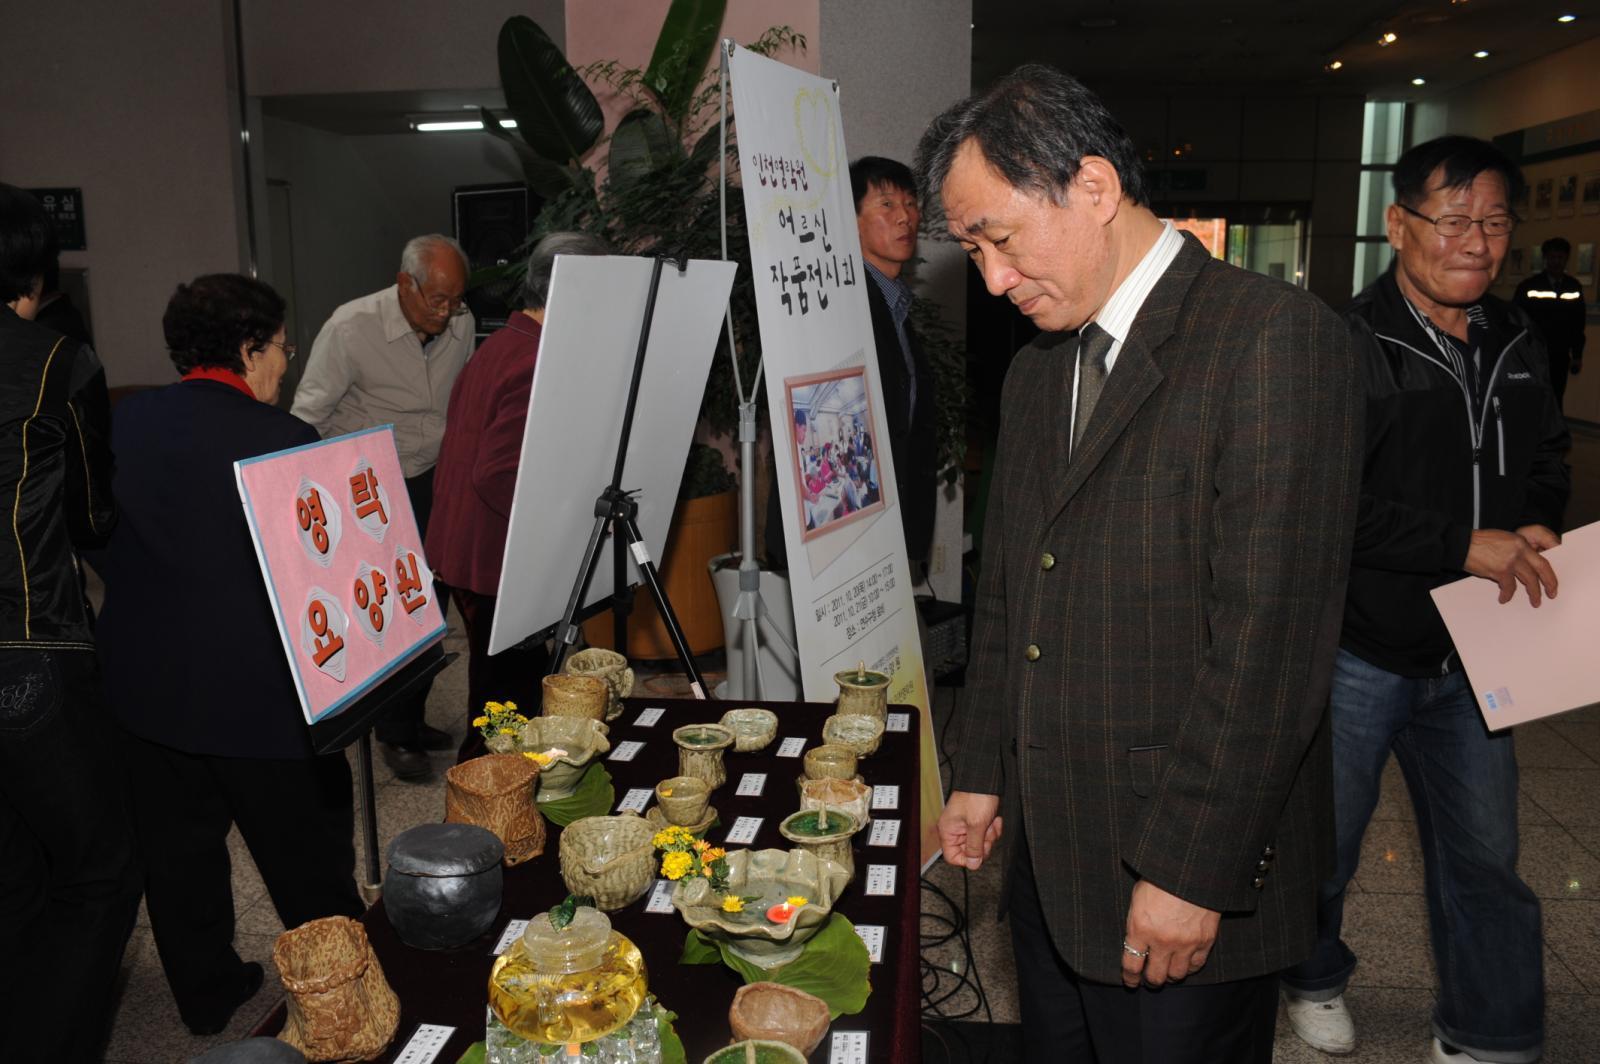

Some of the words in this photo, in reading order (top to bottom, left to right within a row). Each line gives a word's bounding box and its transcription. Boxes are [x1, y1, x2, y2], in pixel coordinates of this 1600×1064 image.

[752, 152, 808, 192] 인천영락원
[778, 205, 832, 252] 어르신
[770, 254, 856, 316] 작품전시회
